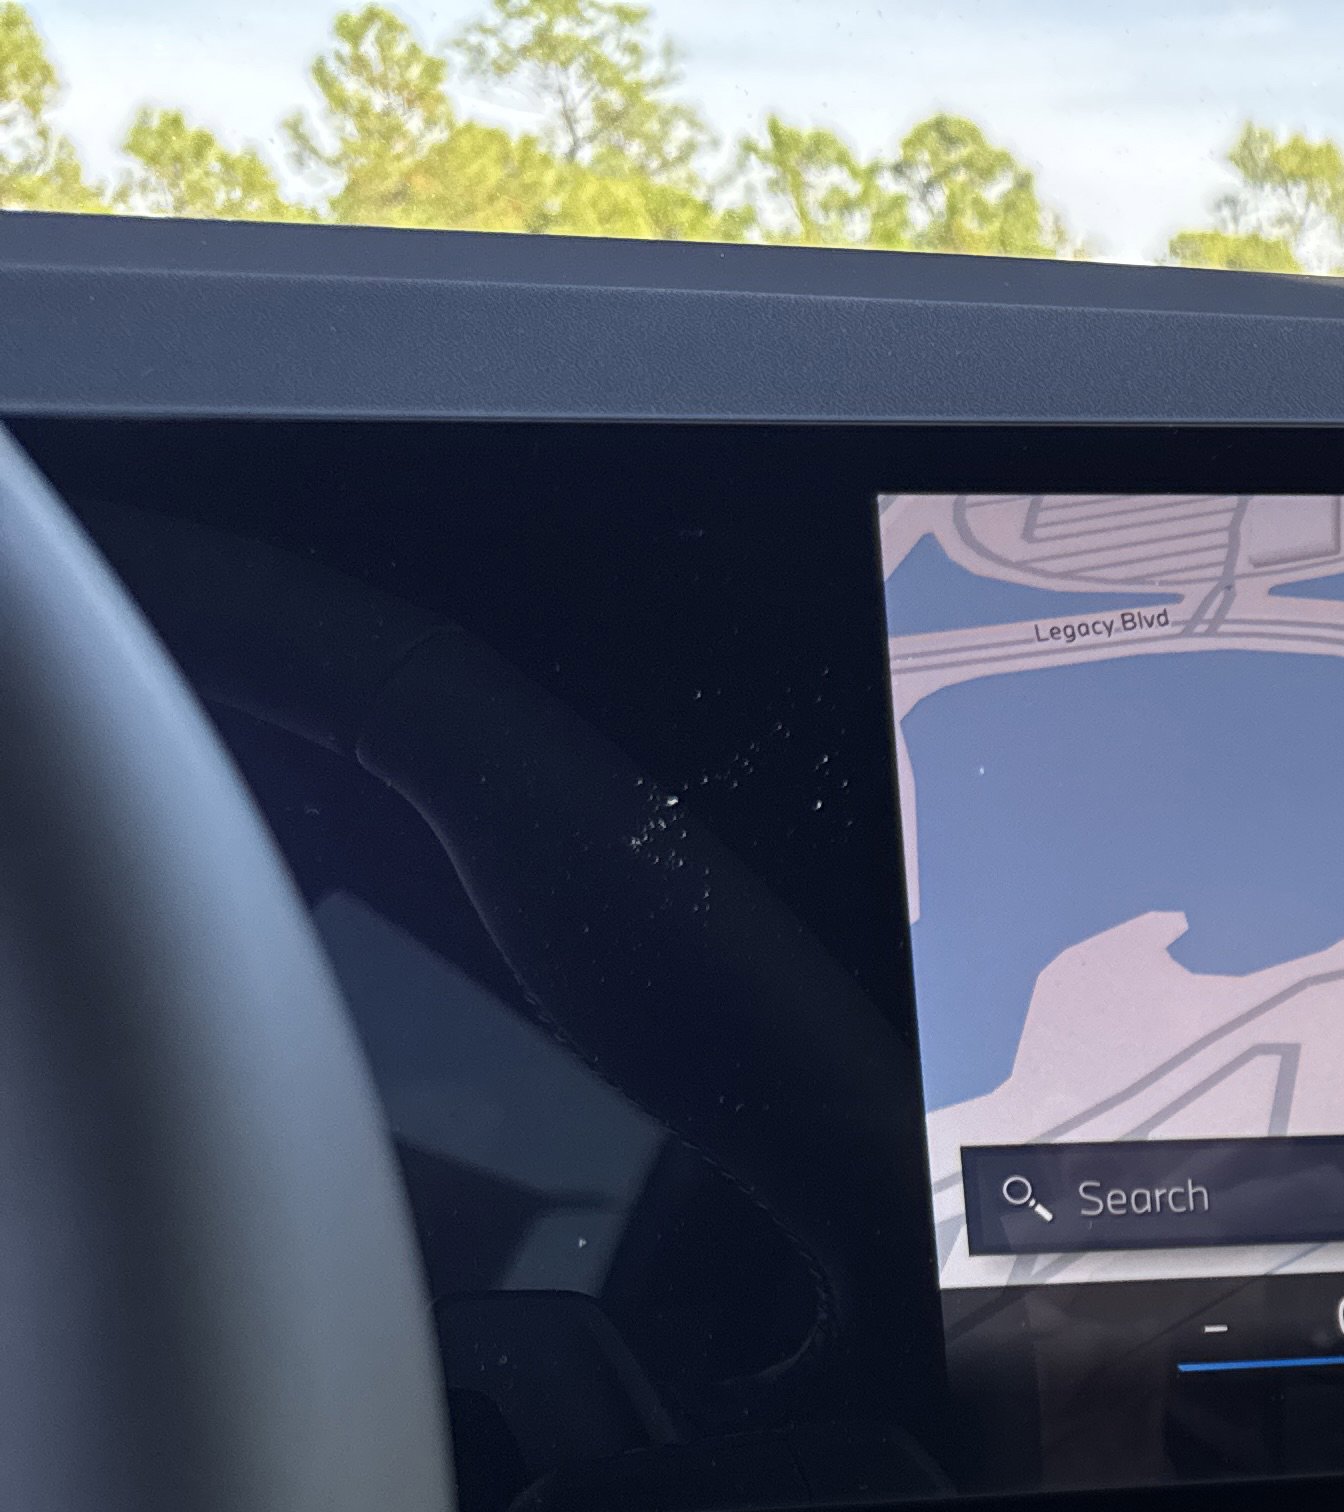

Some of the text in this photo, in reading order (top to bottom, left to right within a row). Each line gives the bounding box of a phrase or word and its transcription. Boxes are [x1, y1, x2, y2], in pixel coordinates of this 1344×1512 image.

[1034, 608, 1170, 643] Legacy Blvd
[1078, 1178, 1209, 1216] Search
